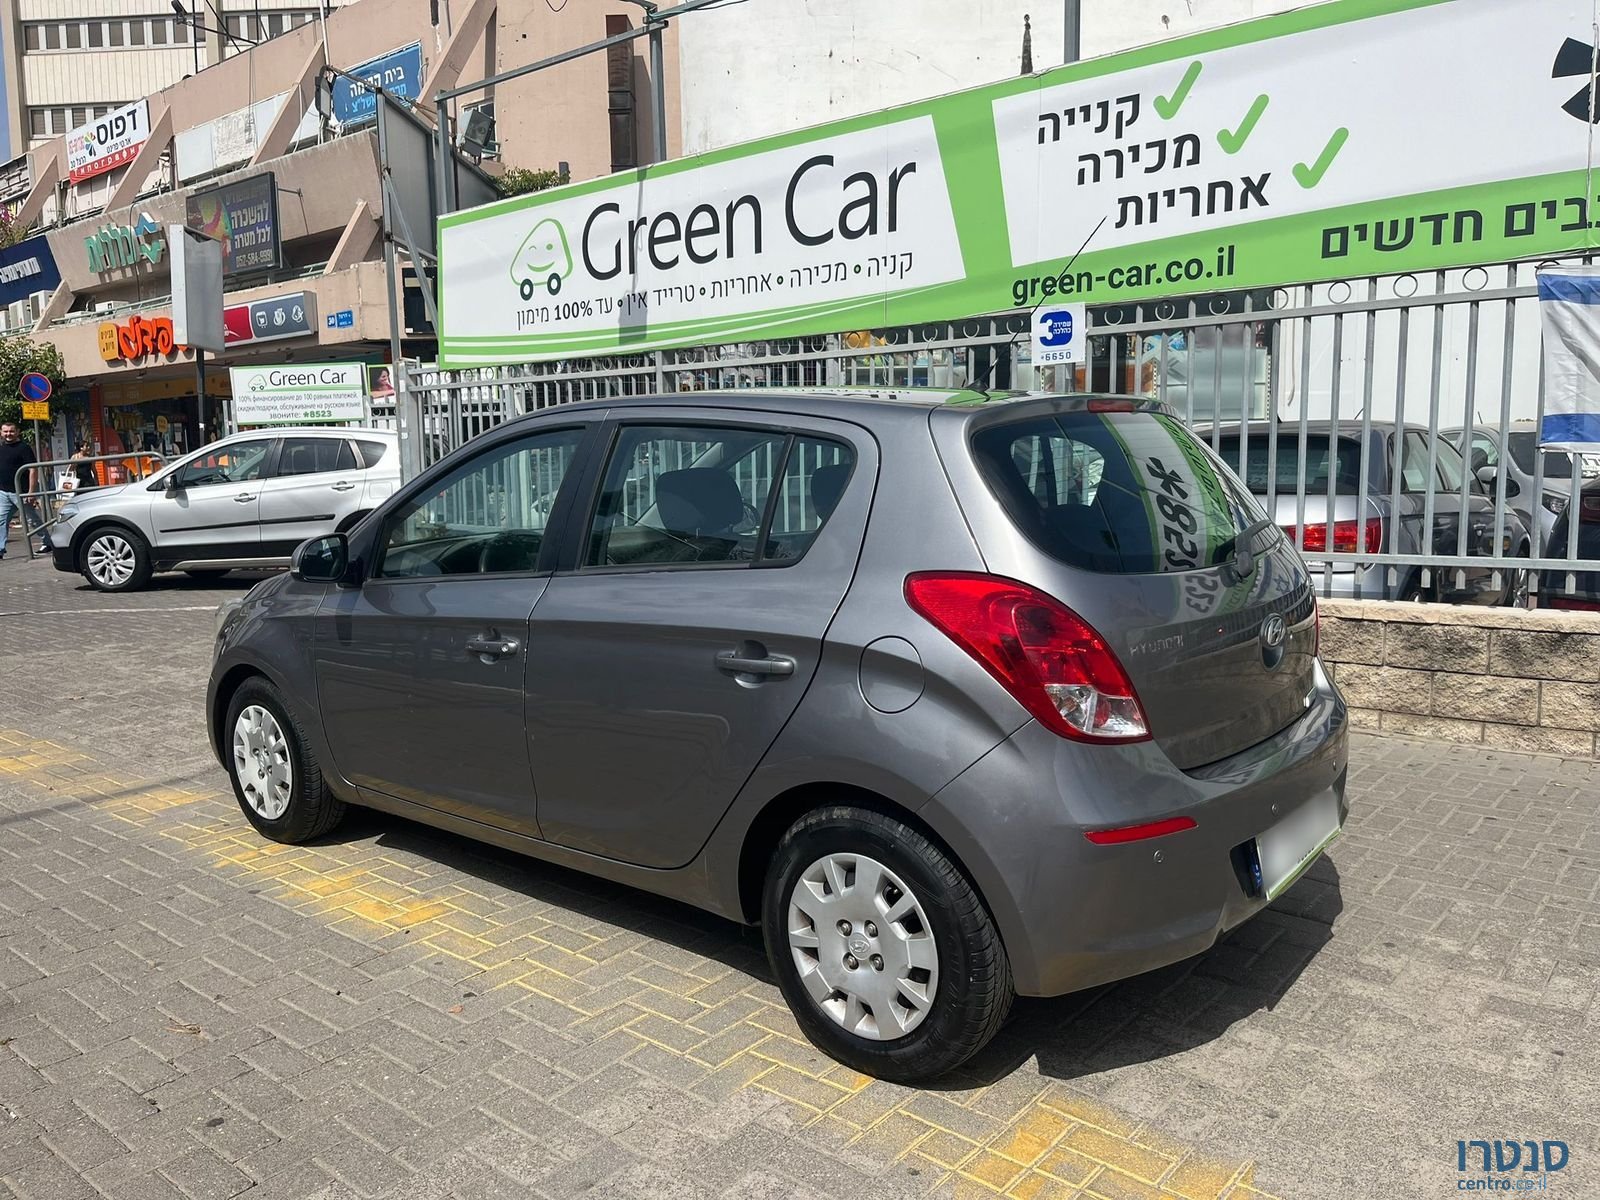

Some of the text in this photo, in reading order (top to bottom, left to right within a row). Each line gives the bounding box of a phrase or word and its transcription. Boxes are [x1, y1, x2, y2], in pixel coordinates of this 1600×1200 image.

[385, 66, 405, 85] בית
[96, 108, 137, 146] דפוס
[1038, 93, 1140, 145] קנייה
[1077, 133, 1201, 186] מכירה
[230, 200, 270, 230] להשכרה
[582, 154, 917, 281] Green Car
[1115, 172, 1271, 229] אחריות
[1321, 194, 1600, 259] בים חדשים
[516, 252, 913, 331] קניה מכירה אחריות טרייד אין עד 100% מימון
[1012, 244, 1235, 306] green-car.co.il
[1052, 321, 1072, 329] שמירה
[269, 369, 347, 387] Green Car
